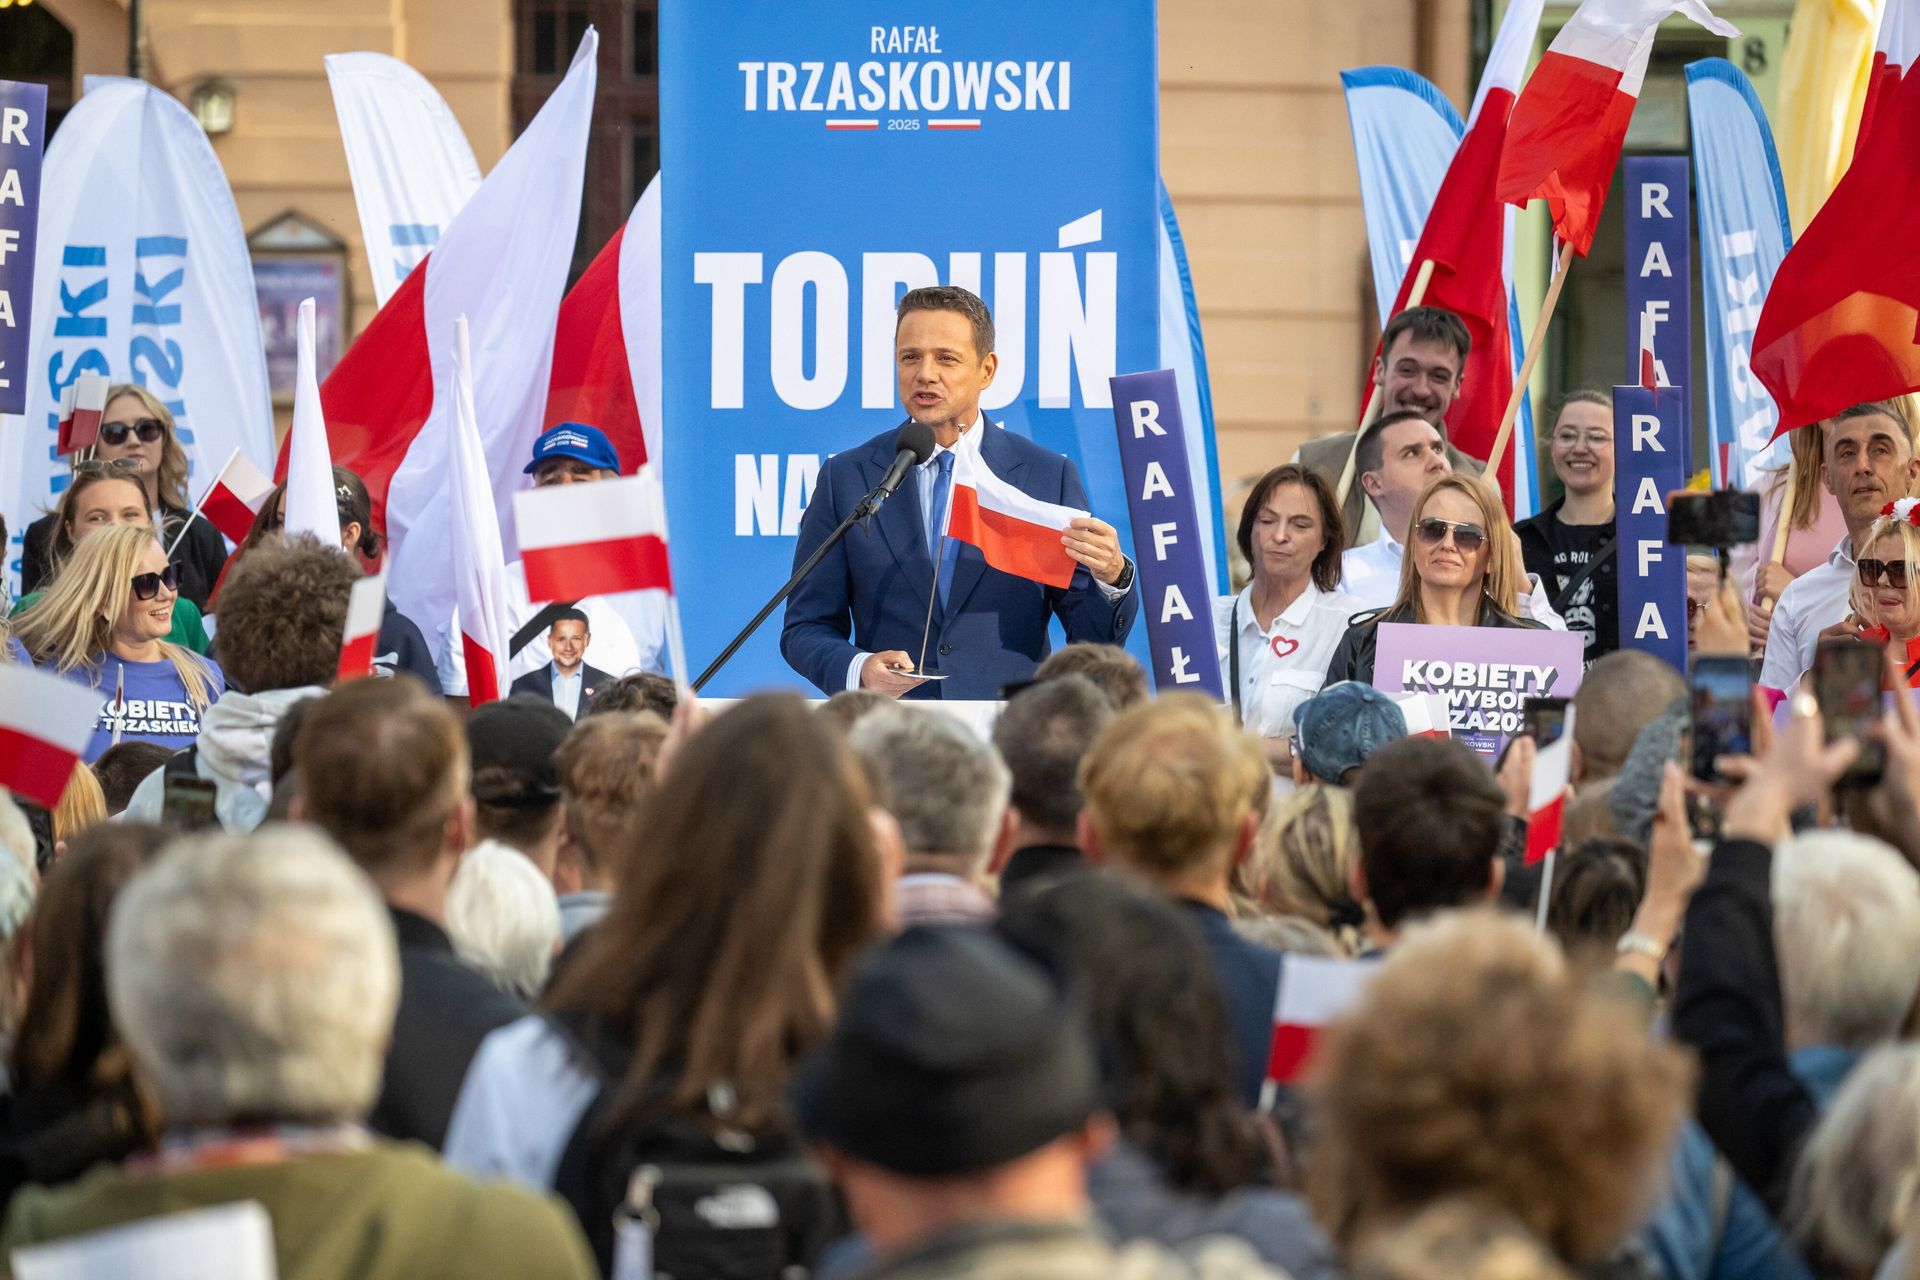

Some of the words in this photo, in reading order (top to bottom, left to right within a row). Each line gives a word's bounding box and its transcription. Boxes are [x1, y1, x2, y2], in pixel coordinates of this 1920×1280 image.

[870, 26, 942, 53] RAFAŁ
[738, 61, 1071, 111] TRZASKOWSKI
[887, 119, 921, 131] 2025
[694, 208, 1117, 410] TORUŃ
[1130, 399, 1200, 684] RAFAŁ
[1631, 414, 1669, 640] RAFA
[1571, 551, 1594, 563] ROL
[1402, 659, 1555, 690] KOBIETY
[1438, 688, 1552, 710] WYBO
[103, 717, 200, 733] TRZASKIEM
